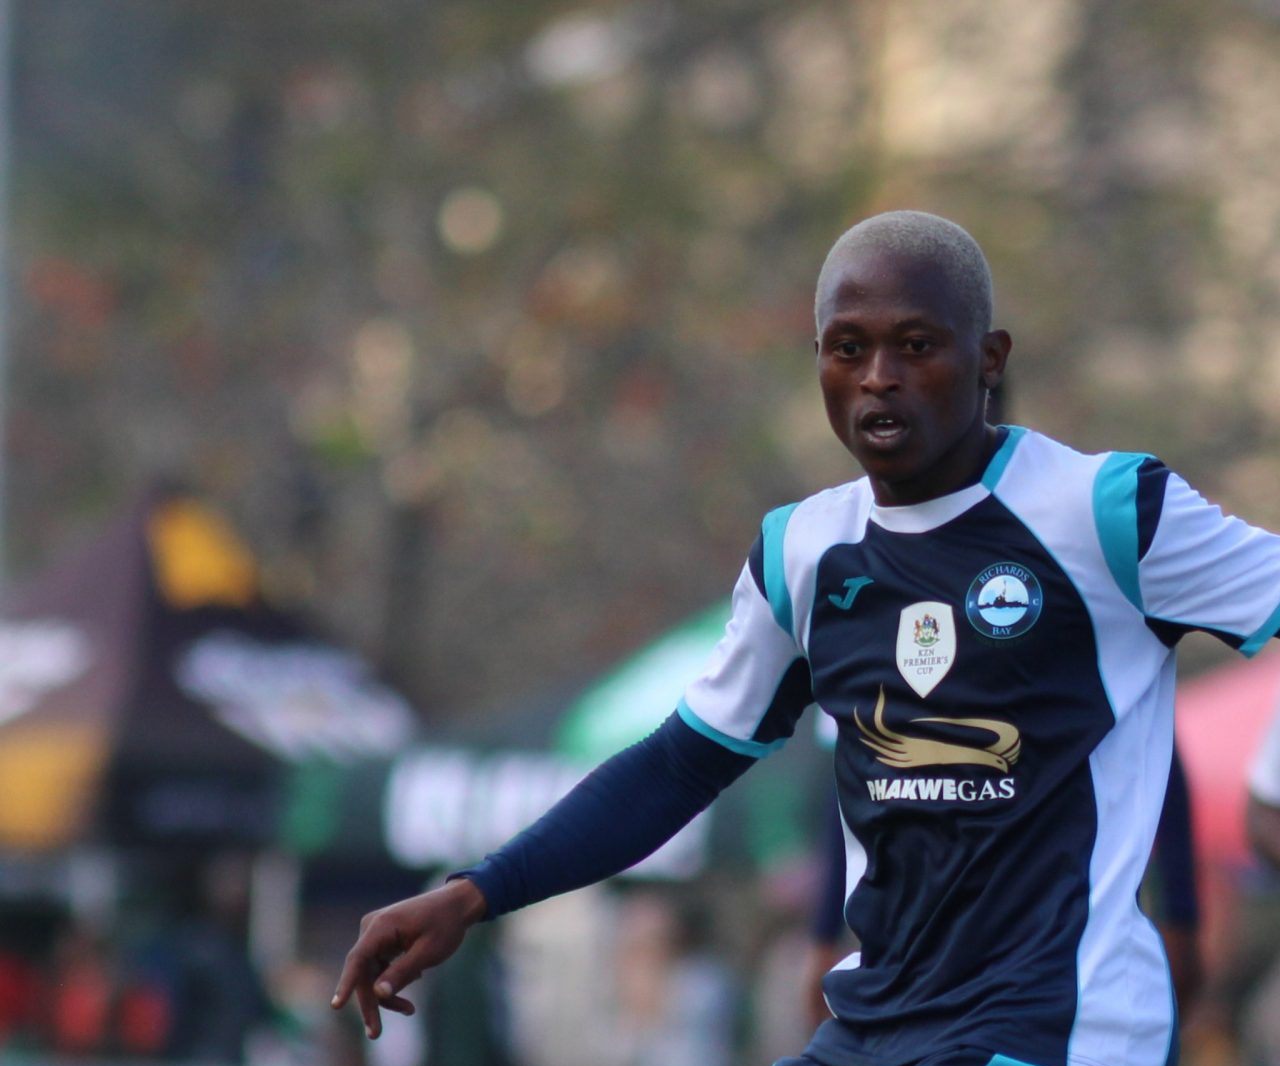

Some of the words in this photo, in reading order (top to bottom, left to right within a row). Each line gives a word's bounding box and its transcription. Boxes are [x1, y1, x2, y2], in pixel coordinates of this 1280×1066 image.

[979, 565, 1029, 584] RICHARDS
[992, 626, 1012, 635] BAY
[918, 648, 935, 657] KZN
[903, 655, 948, 667] PREMIER'S
[916, 666, 934, 675] CUP
[866, 778, 1016, 801] PHAKWEGAS
